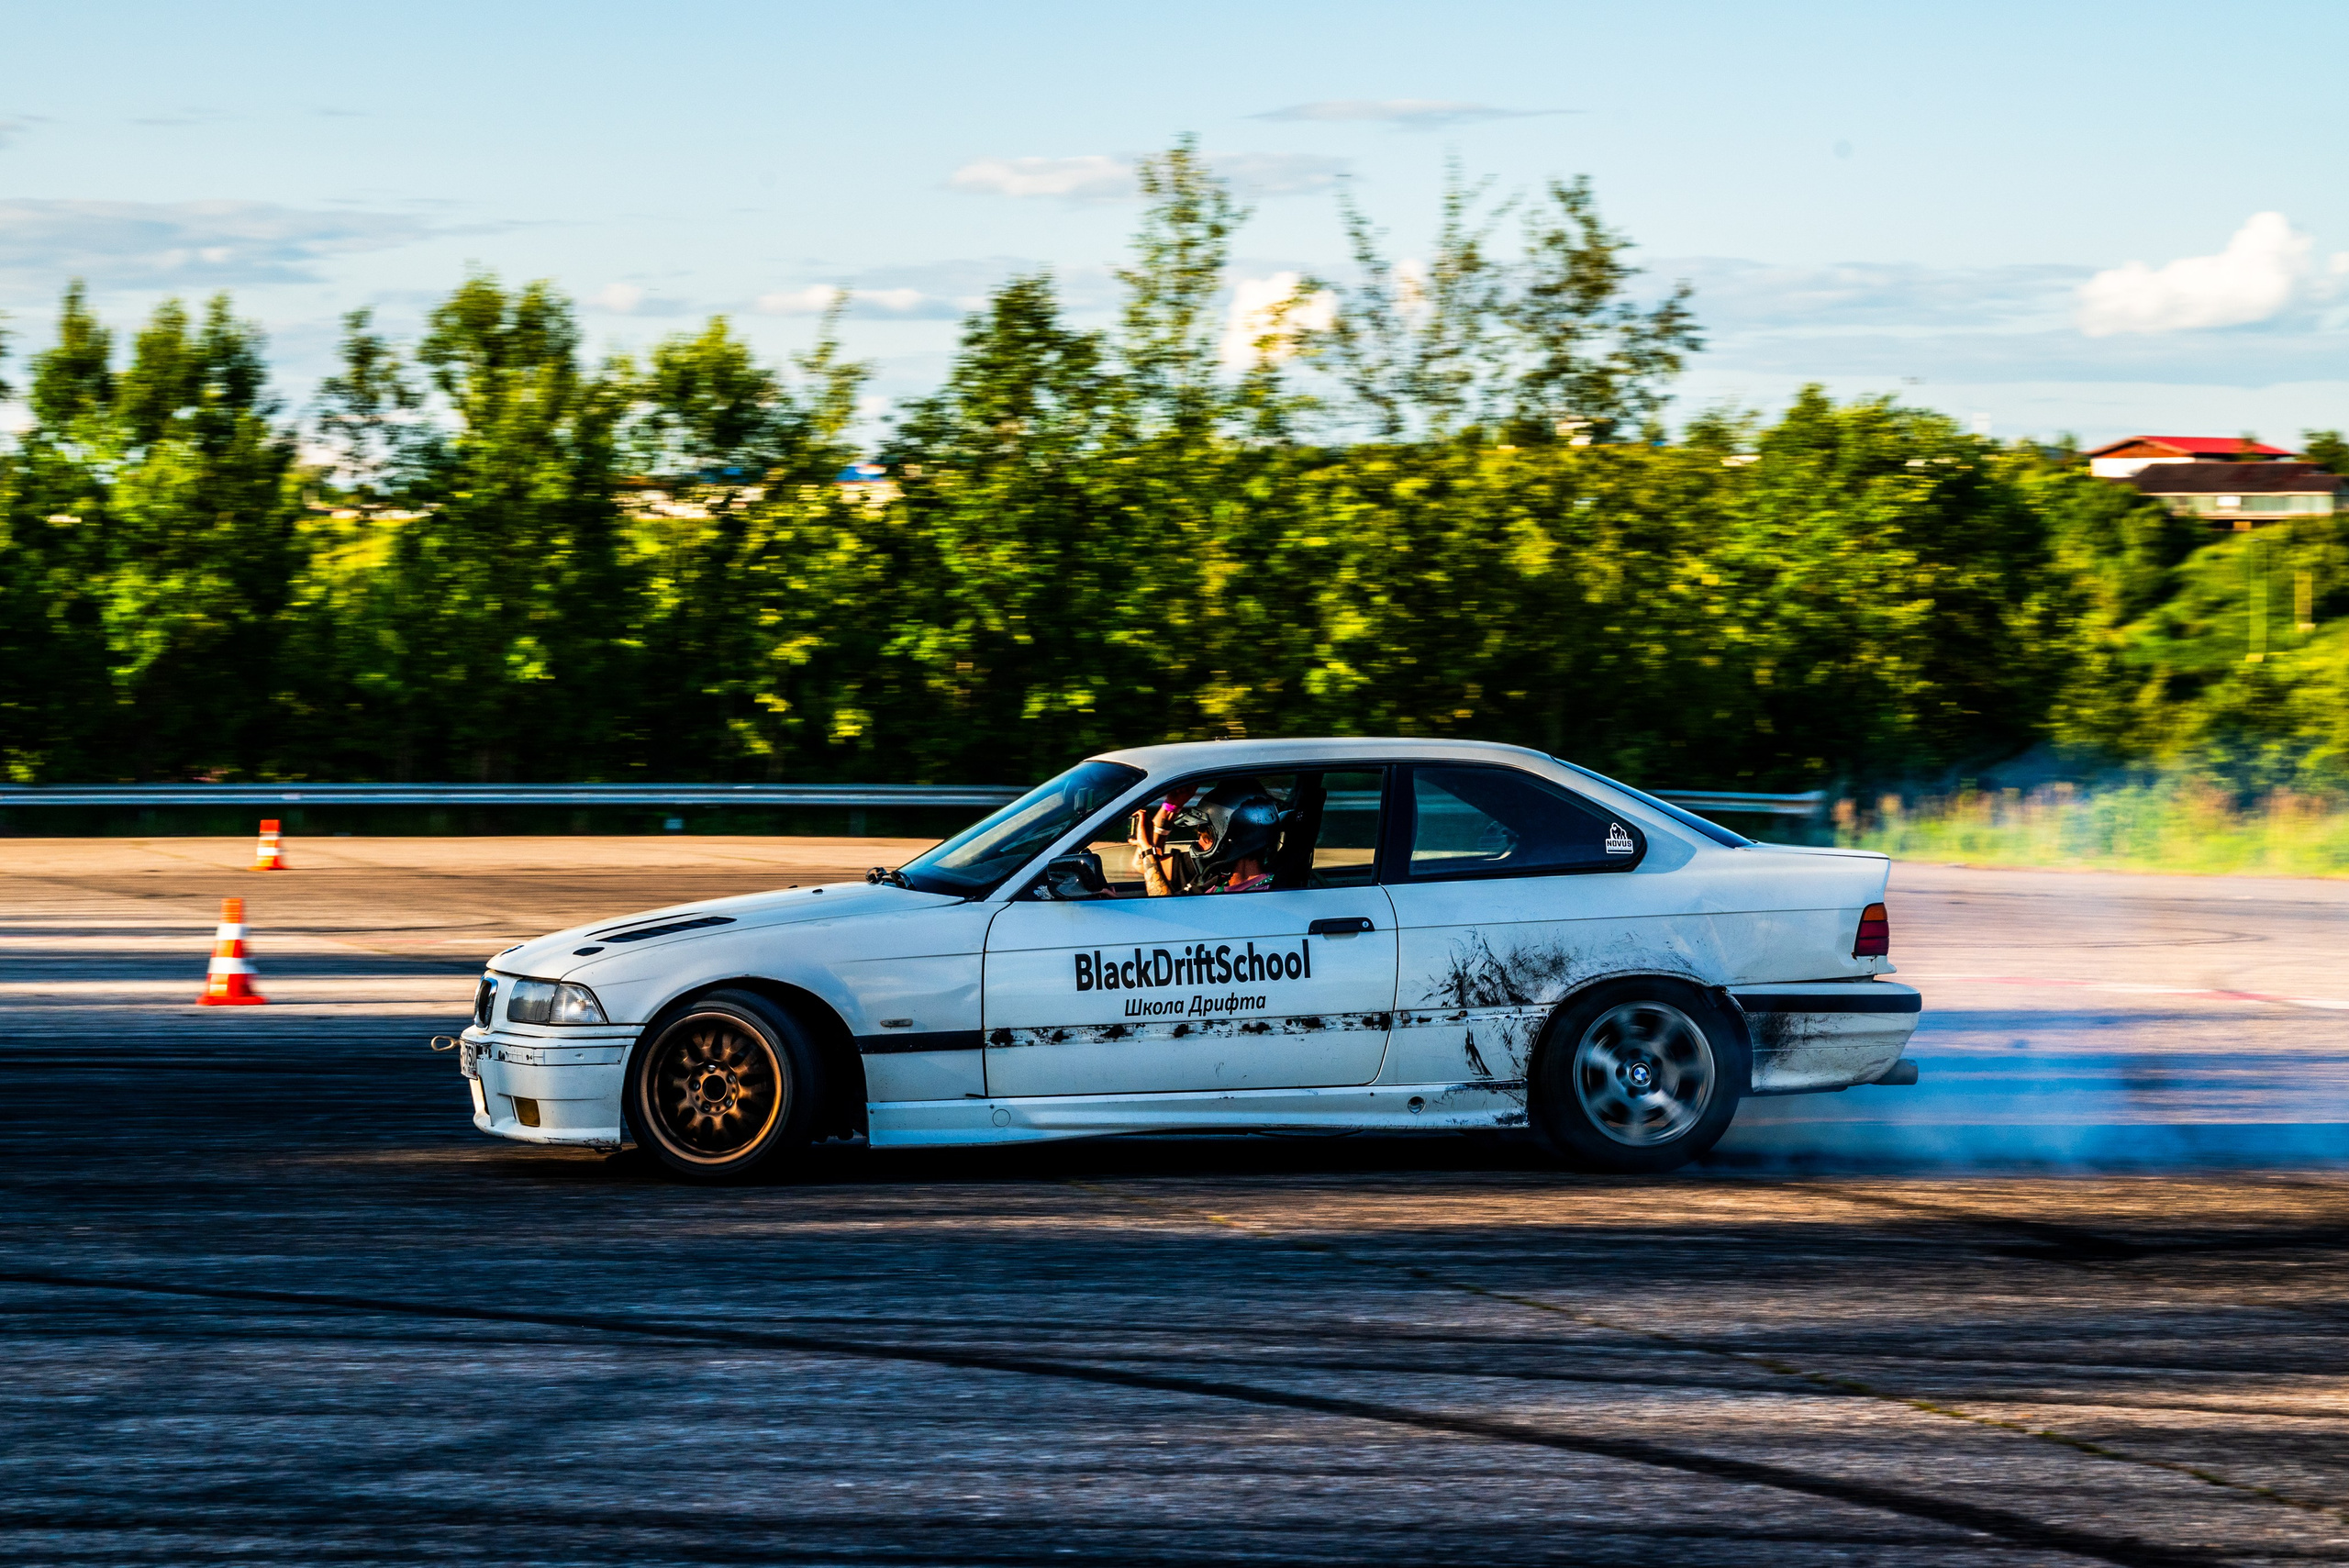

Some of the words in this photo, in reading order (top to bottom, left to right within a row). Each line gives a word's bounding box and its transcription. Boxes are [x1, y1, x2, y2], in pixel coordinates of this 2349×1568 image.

[1074, 939, 1311, 992] BlackDriftSchool
[1124, 998, 1185, 1017] Школа
[1187, 992, 1266, 1018] Дрифта
